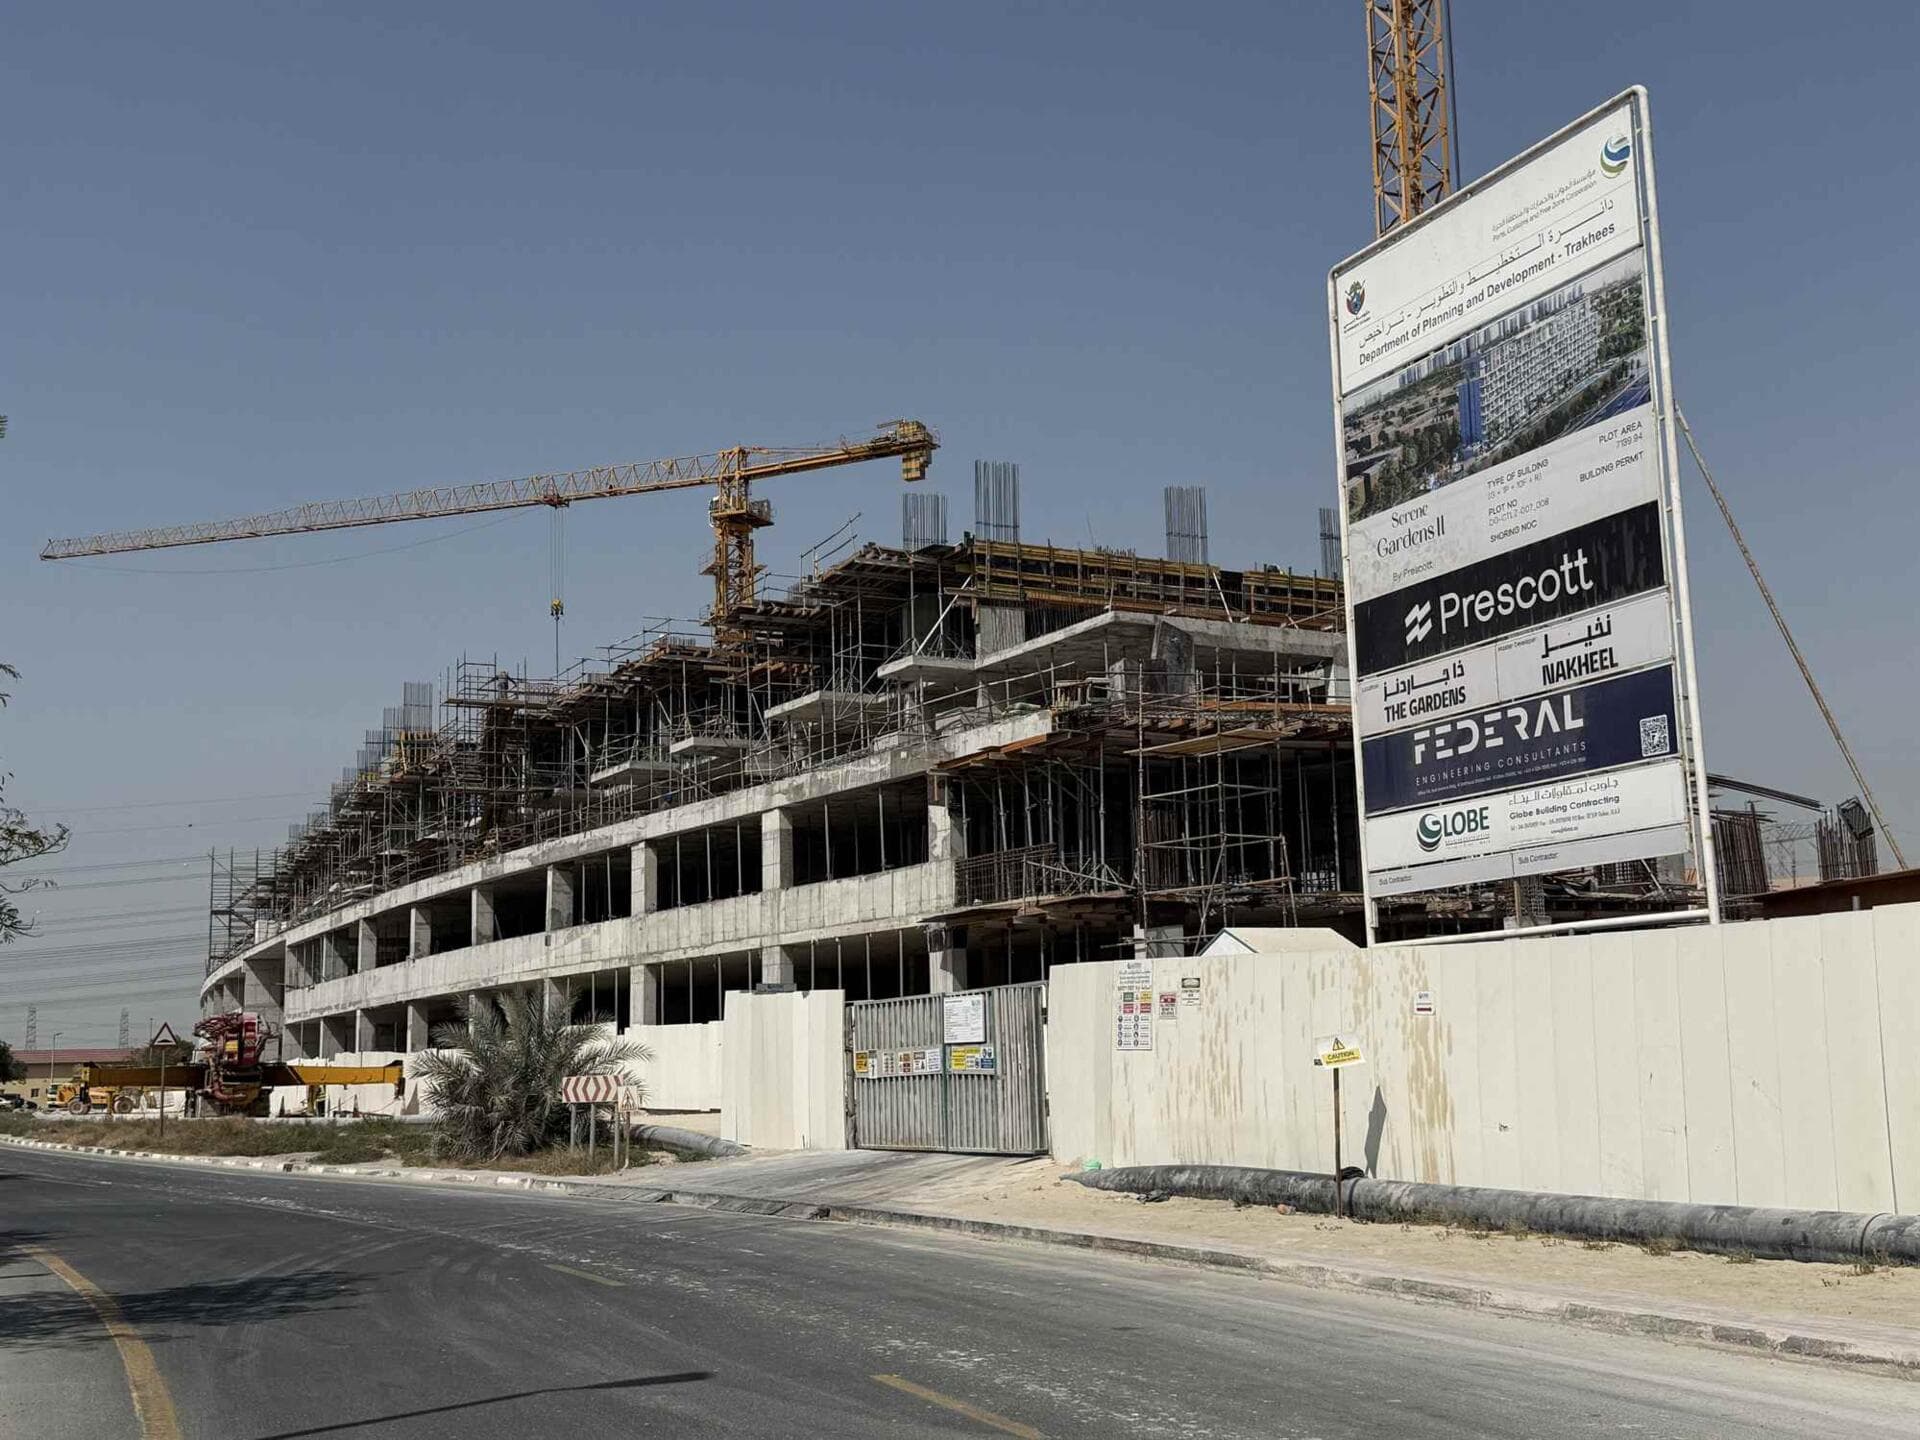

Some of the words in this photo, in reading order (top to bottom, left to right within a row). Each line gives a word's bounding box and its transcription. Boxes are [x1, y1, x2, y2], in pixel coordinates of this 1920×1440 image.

[1360, 333, 1410, 365] Department
[1411, 322, 1421, 338] of
[1422, 303, 1464, 332] Planning
[1466, 291, 1485, 309] and
[1487, 253, 1556, 298] Development
[1564, 223, 1616, 257] Trakhees
[1599, 429, 1618, 444] PLOT
[1621, 421, 1642, 436] AREA
[1487, 476, 1505, 489] TYPE
[1506, 471, 1516, 482] OF
[1517, 458, 1549, 478] BUILDING
[1579, 462, 1614, 482] BUILDING
[1615, 451, 1644, 469] PERMIT
[1391, 504, 1429, 529] Serene
[1488, 503, 1506, 517] PLOT
[1507, 499, 1518, 510] NO
[1377, 523, 1435, 558] Gardens
[1436, 515, 1446, 537] II
[1490, 525, 1520, 543] SHORING
[1521, 519, 1538, 533] NOC
[1403, 561, 1434, 578] Prescott
[1439, 548, 1595, 635] Prescott
[1541, 647, 1619, 686] NAKHEEL
[1384, 702, 1407, 723] THE
[1409, 686, 1466, 716] GARDENS
[1413, 694, 1584, 765] FEDERAL
[1416, 761, 1491, 786] ENGINEERING
[1497, 741, 1587, 769] CONSULTANTS
[1509, 809, 1534, 820] Globe
[1535, 803, 1568, 816] Building
[1569, 795, 1620, 810] Contracting
[1327, 1050, 1355, 1061] CAUTION
